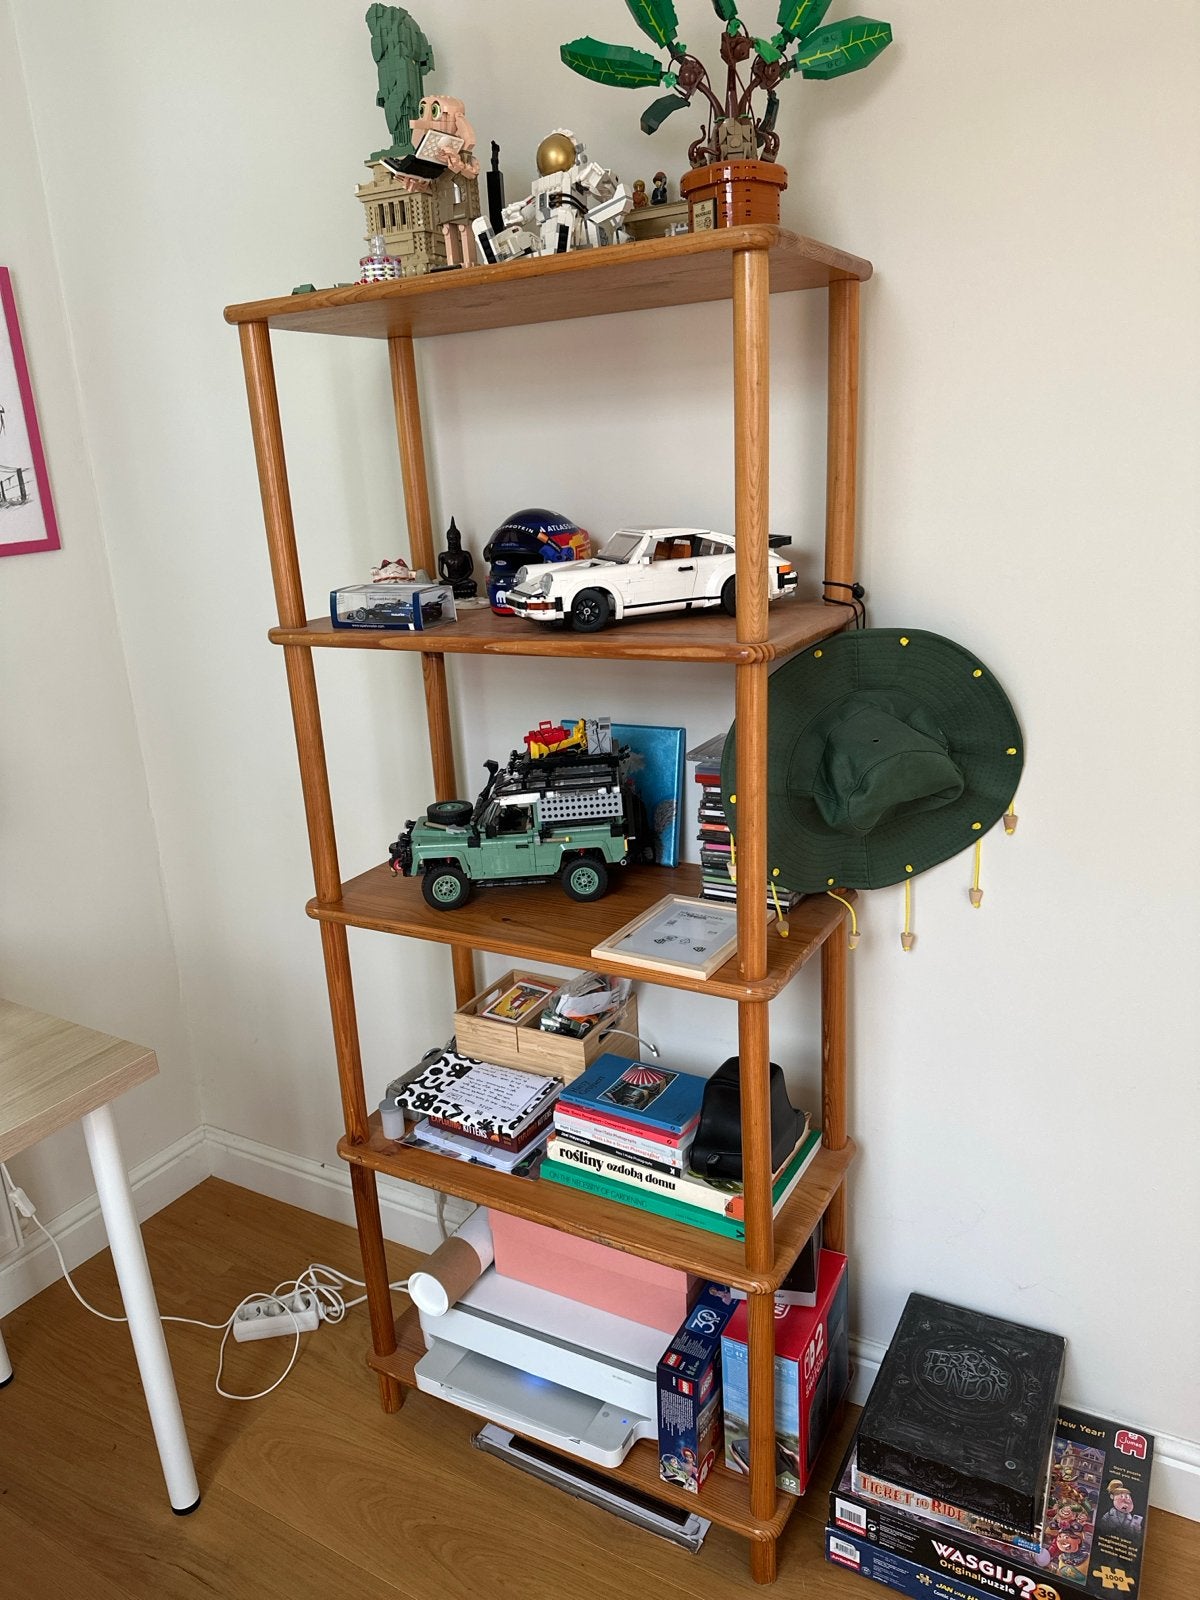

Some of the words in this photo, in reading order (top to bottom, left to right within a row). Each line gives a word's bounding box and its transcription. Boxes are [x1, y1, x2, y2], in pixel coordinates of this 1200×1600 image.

[462, 1124, 488, 1139] KITTENS
[559, 1147, 604, 1171] rośliny
[606, 1161, 643, 1182] ozdobą
[645, 1172, 676, 1190] domu
[549, 1171, 559, 1179] ON
[572, 1177, 600, 1192] NECESSITY
[600, 1186, 609, 1195] OF
[610, 1189, 647, 1207] GARDENING
[924, 1349, 1010, 1391] TERRORS
[922, 1363, 1008, 1404] LONDON
[1080, 1424, 1106, 1438] Year!
[860, 1474, 914, 1505] TICKET
[916, 1499, 929, 1510] TO
[931, 1498, 967, 1522] RIDE
[935, 1583, 953, 1593] JAN
[1104, 1574, 1124, 1583] 1000
[1038, 1588, 1056, 1600] 39
